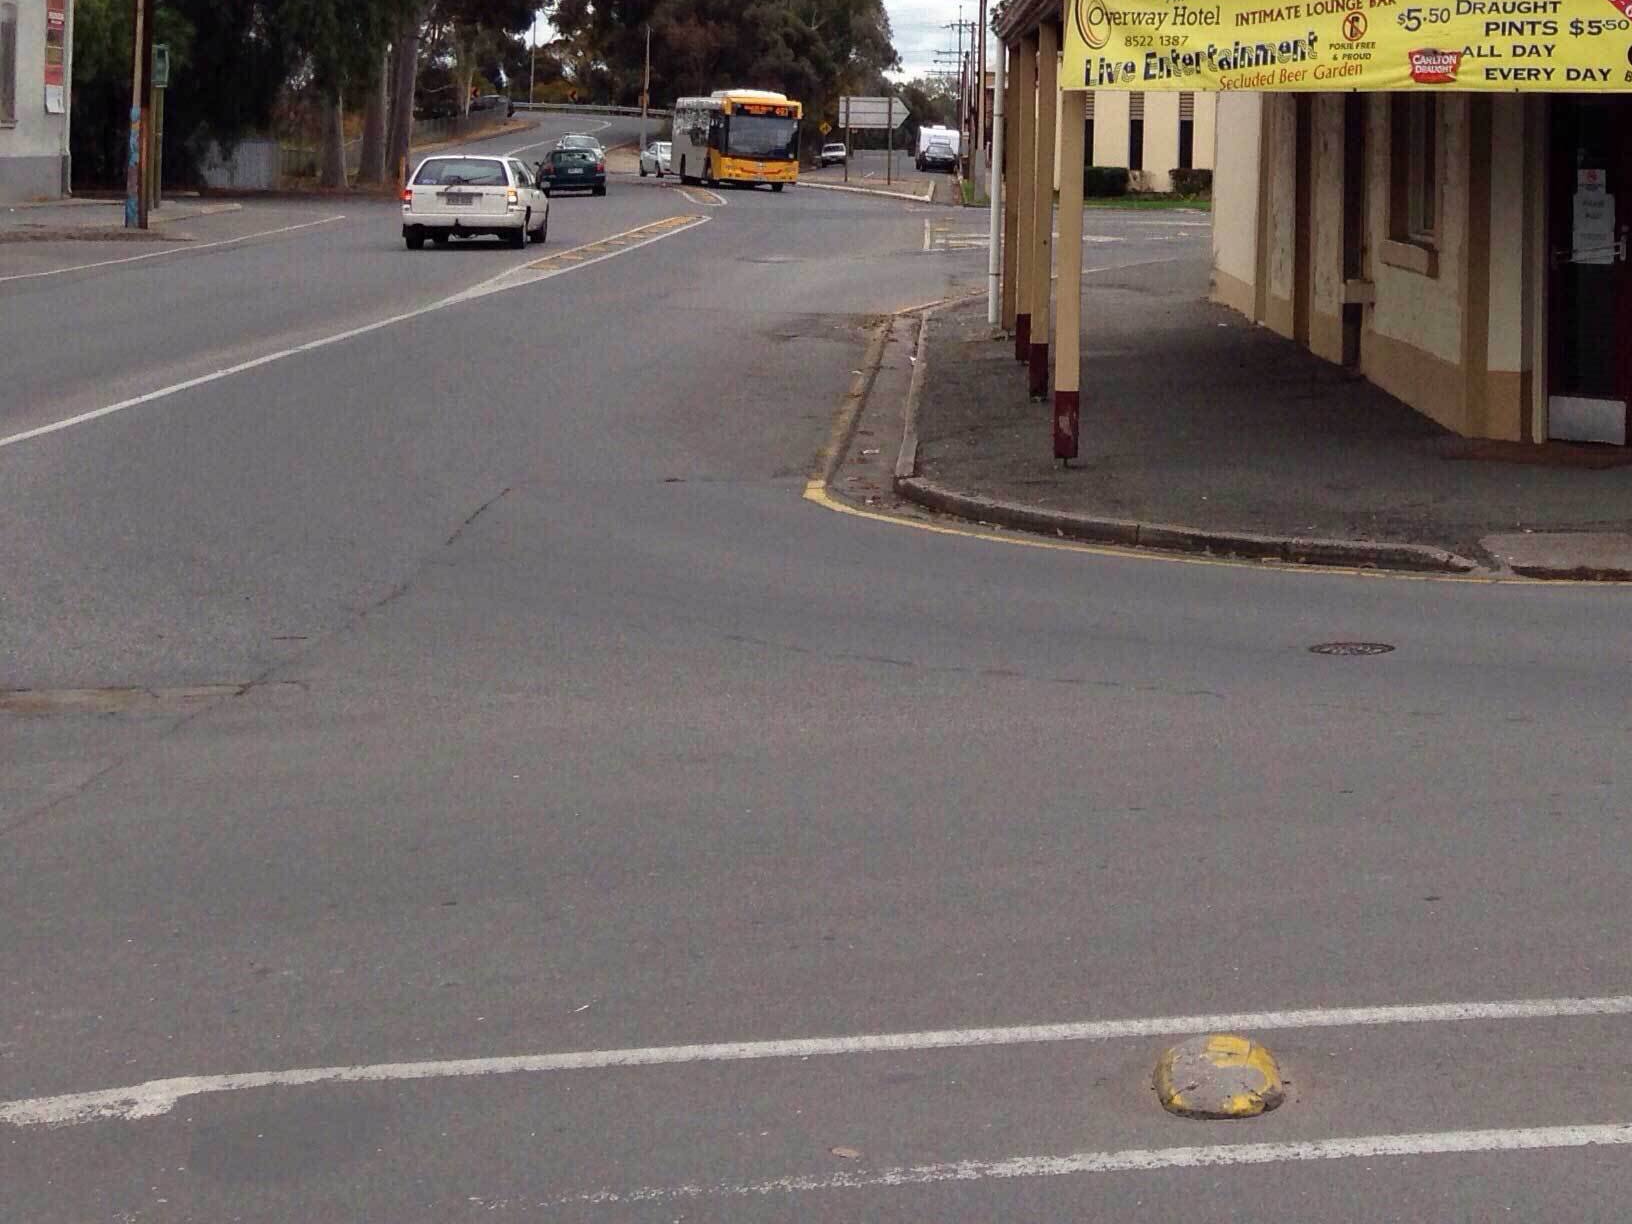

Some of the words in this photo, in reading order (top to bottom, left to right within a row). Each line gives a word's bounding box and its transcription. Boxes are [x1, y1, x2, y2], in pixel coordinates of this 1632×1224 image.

[1455, 0, 1561, 15] DRAUGHT
[1088, 6, 1168, 30] Overway
[1172, 6, 1220, 26] Hotel
[1235, 5, 1300, 26] INTIMATE
[1397, 8, 1450, 31] $5.50
[1485, 21, 1558, 37] PINTS
[1124, 36, 1153, 47] 8522
[1159, 35, 1189, 46] 1387
[1355, 41, 1376, 49] FREE
[1085, 57, 1136, 86] Live
[1143, 29, 1318, 80] Entertainment
[1342, 52, 1371, 60] PROUD
[1462, 45, 1502, 58] ALL
[1512, 45, 1555, 58] DAY
[1413, 55, 1457, 65] CARLTON
[1415, 65, 1453, 74] DRAUGHT
[1485, 68, 1555, 81] EVERY
[1566, 68, 1612, 81] DAY
[1219, 72, 1275, 92] Secluded
[1280, 69, 1308, 84] Beer
[1313, 62, 1363, 80] Garden
